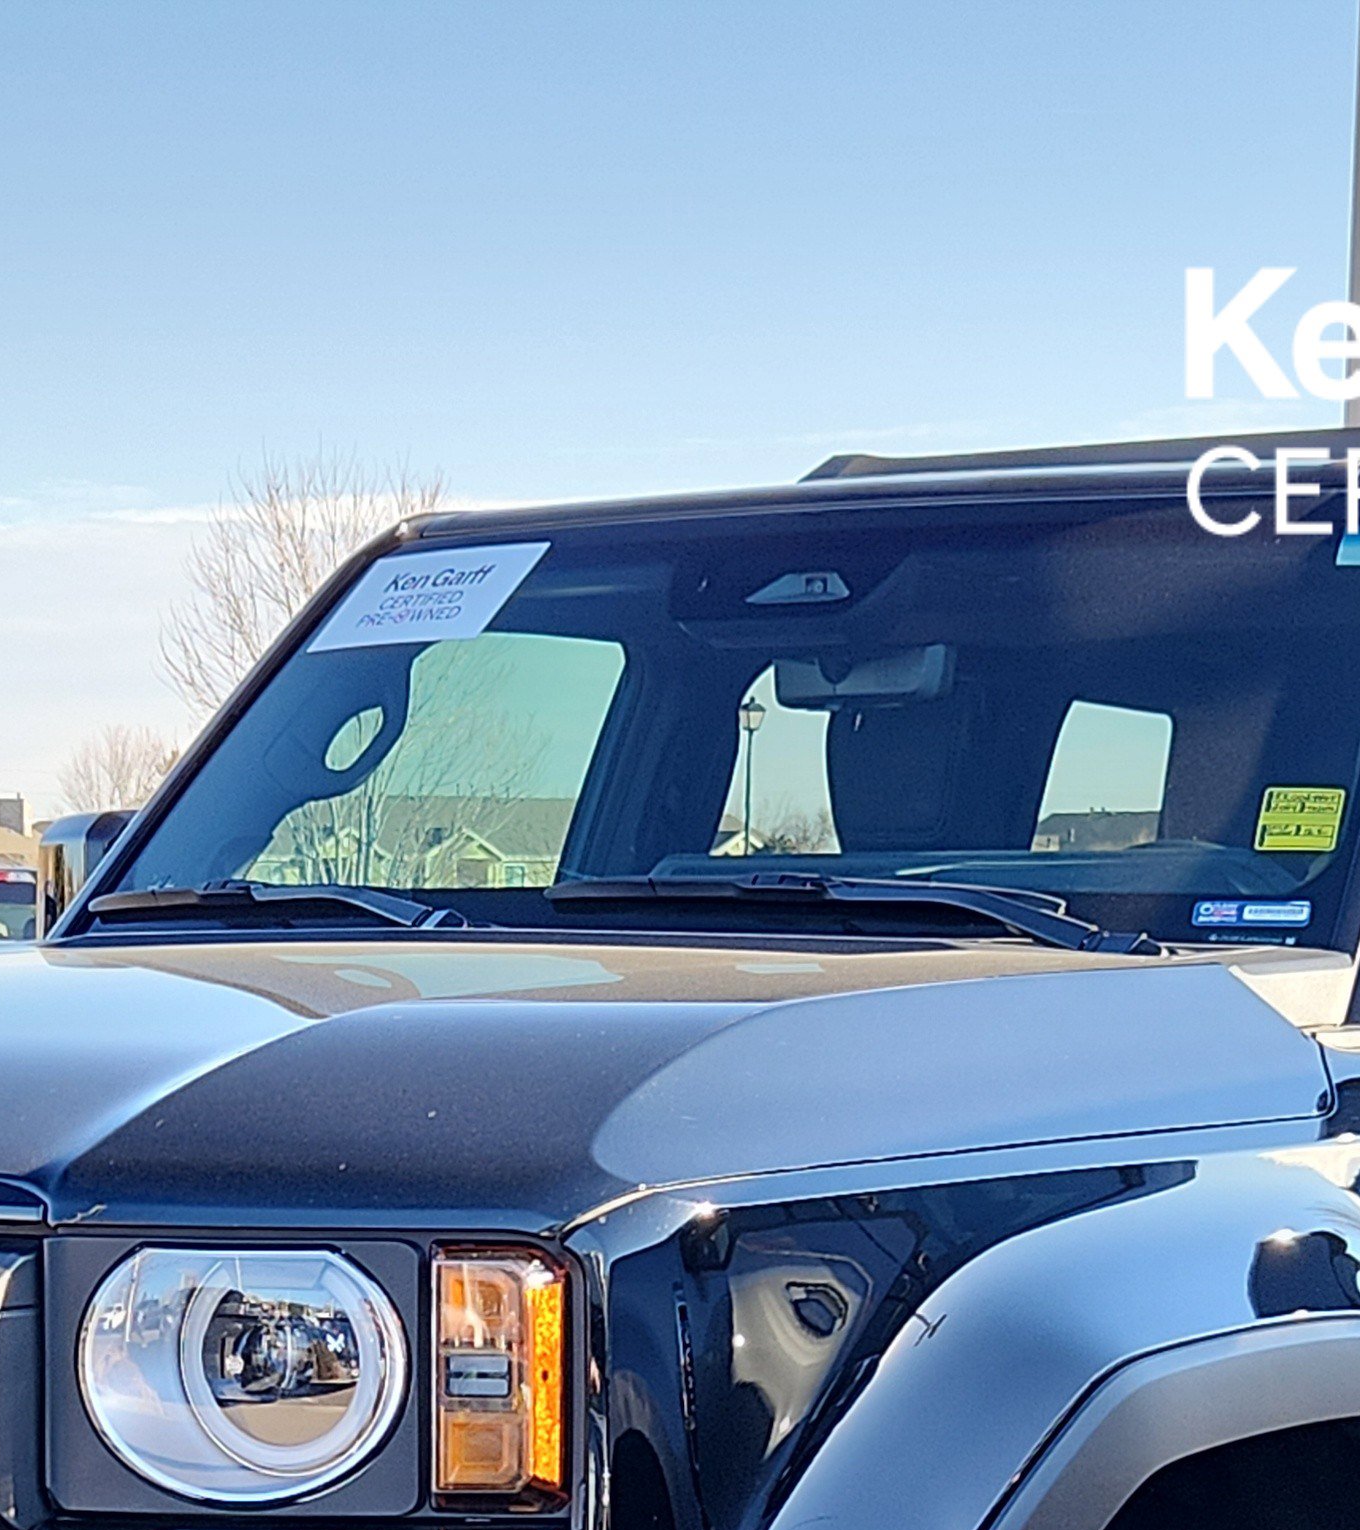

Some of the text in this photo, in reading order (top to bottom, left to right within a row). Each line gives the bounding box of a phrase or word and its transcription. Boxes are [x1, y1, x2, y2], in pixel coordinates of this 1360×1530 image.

[383, 564, 496, 593] Ken Garff
[379, 590, 463, 610] CERTIFIED
